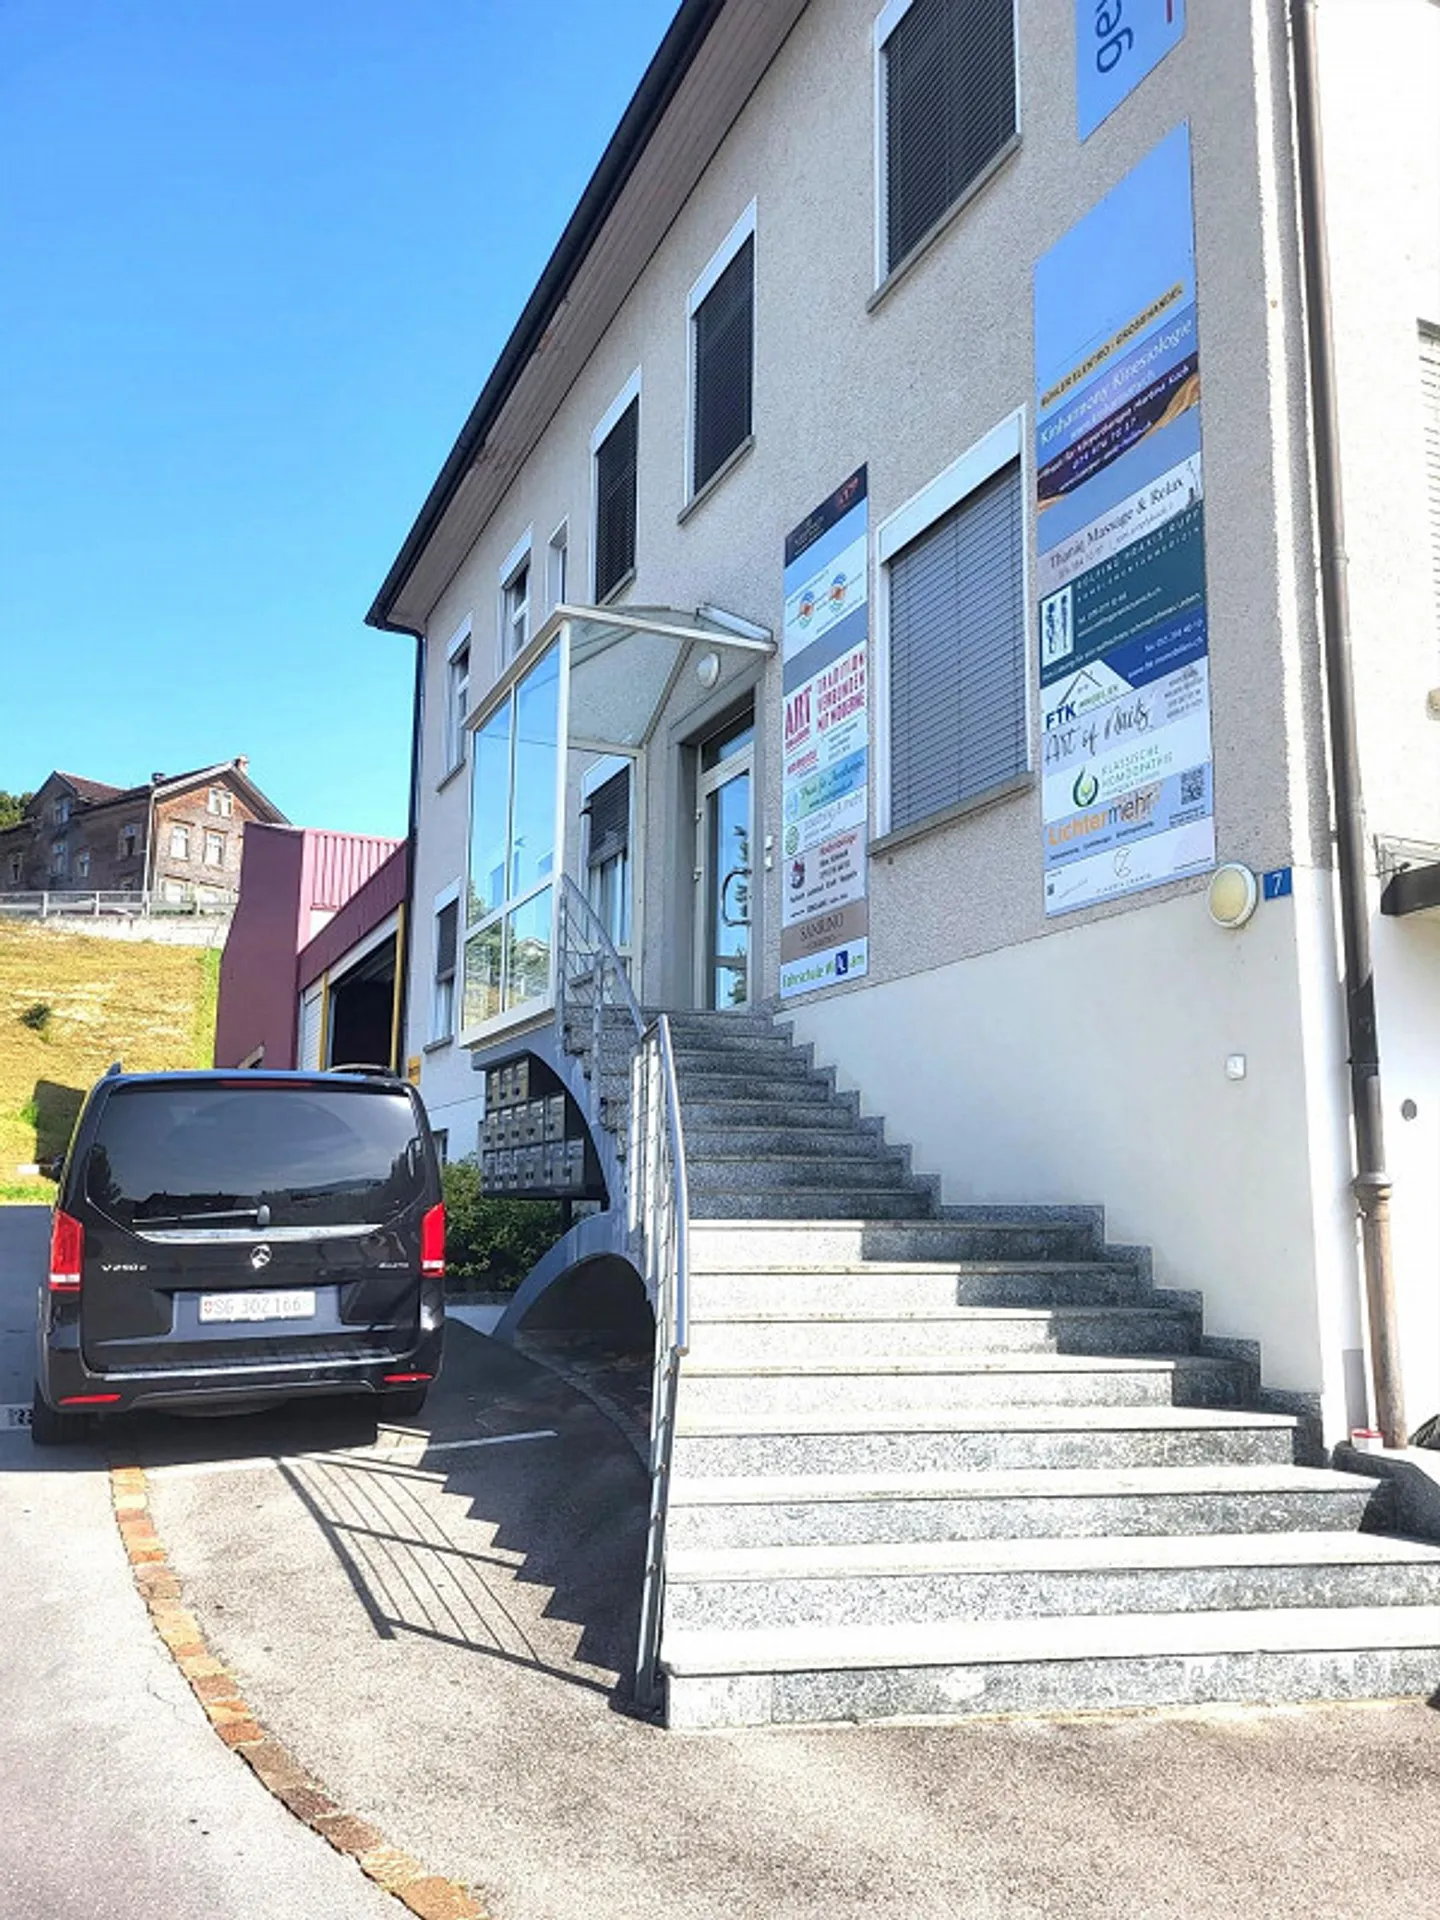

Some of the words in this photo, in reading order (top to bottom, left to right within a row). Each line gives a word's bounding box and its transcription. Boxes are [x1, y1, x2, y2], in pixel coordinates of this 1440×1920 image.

[1095, 0, 1134, 73] ge
[785, 685, 811, 740] ART
[816, 652, 864, 694] TRADITION
[817, 671, 864, 712] VERBUNDEN
[817, 712, 829, 732] MIT
[830, 691, 864, 724] MODERNE
[1045, 701, 1076, 730] FTK
[1048, 791, 1153, 847] Lichtermehr
[1272, 872, 1283, 895] 7
[215, 1296, 234, 1315] SG
